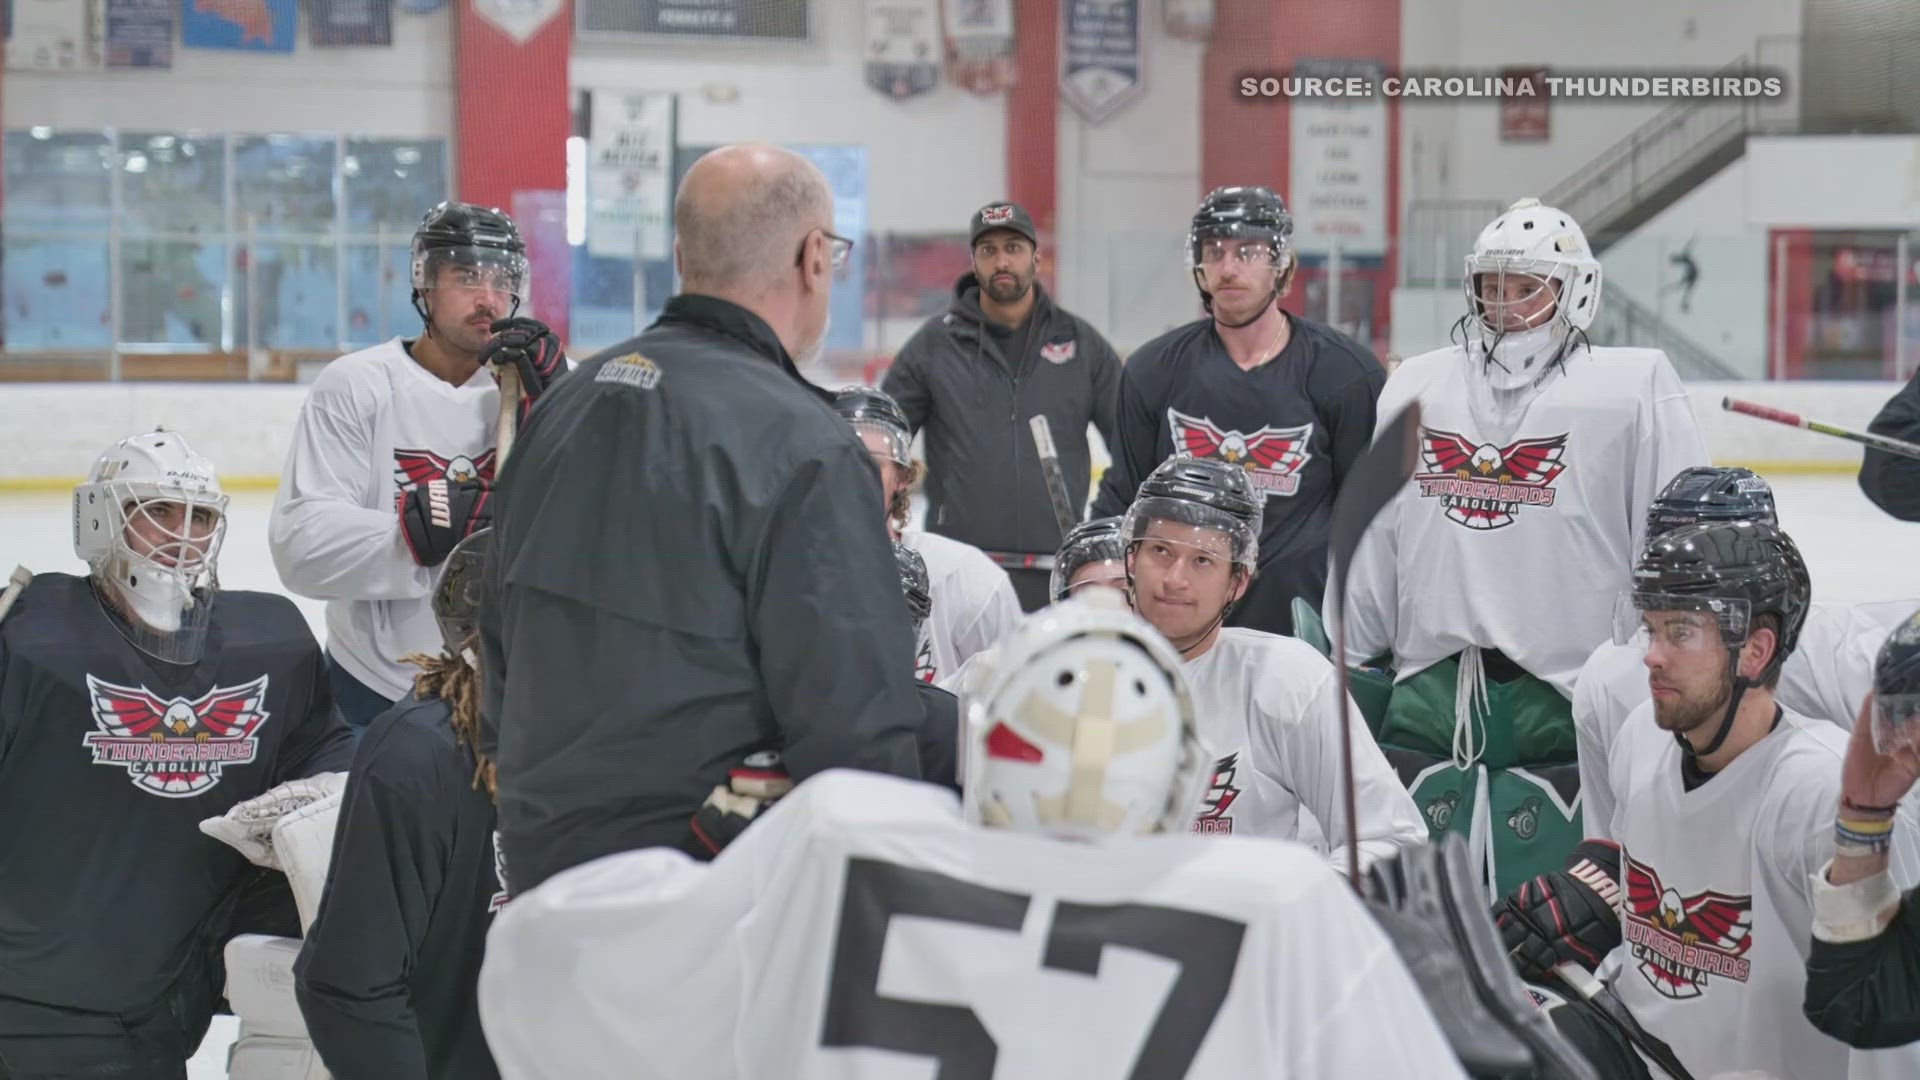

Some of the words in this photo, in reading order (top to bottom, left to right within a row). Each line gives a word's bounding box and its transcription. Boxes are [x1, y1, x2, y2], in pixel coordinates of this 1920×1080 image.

[1421, 480, 1555, 506] THUNDERBIRDS
[1441, 495, 1519, 514] CAROLINA
[100, 742, 253, 761] THUNDERBIRDS
[133, 761, 217, 773] CAROLINA
[819, 855, 1267, 1080] 57
[1632, 943, 1707, 984] CAROLINA
